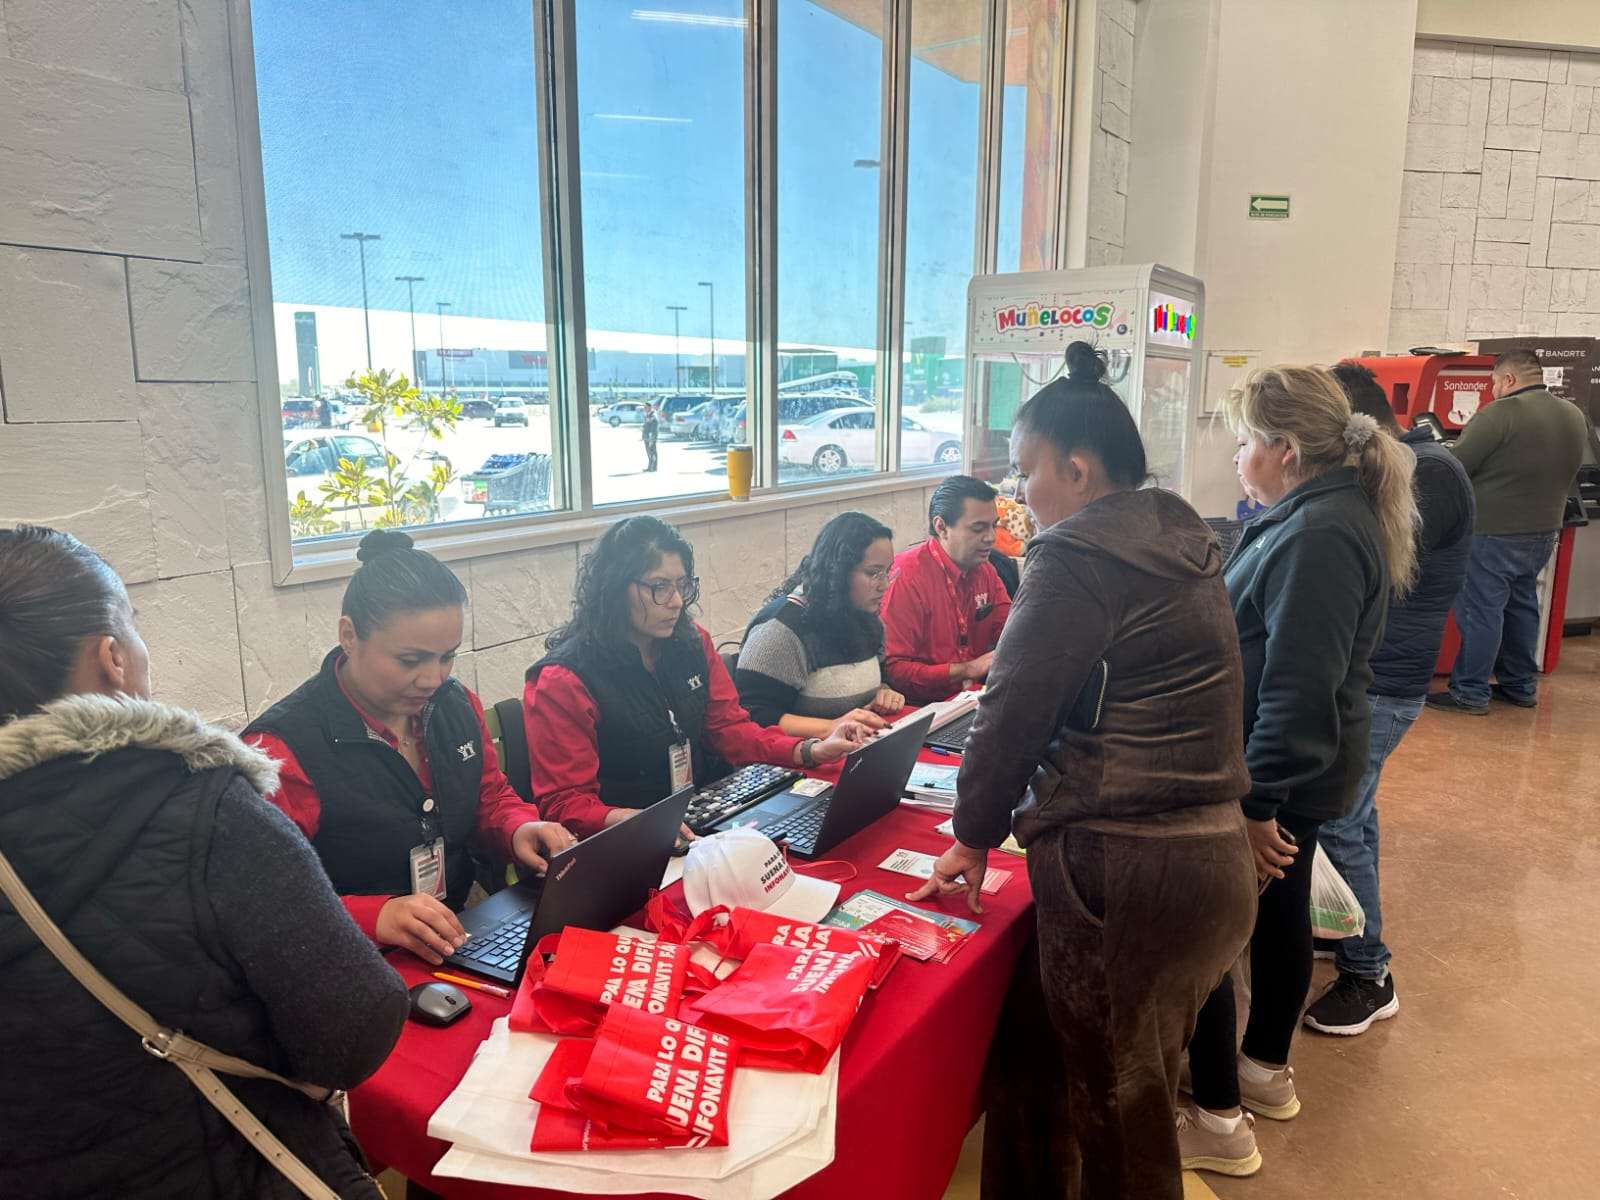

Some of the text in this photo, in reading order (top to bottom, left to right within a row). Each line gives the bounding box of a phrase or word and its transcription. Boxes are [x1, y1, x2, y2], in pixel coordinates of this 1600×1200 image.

[1545, 350, 1586, 358] BANORTE
[1443, 380, 1489, 391] Santander
[760, 861, 784, 885] SUENA
[615, 936, 633, 955] QU
[609, 956, 628, 974] LO
[646, 960, 673, 1015] ONAVIT
[646, 1017, 682, 1104] PARA LO Q
[665, 1023, 707, 1128] UENA DIF
